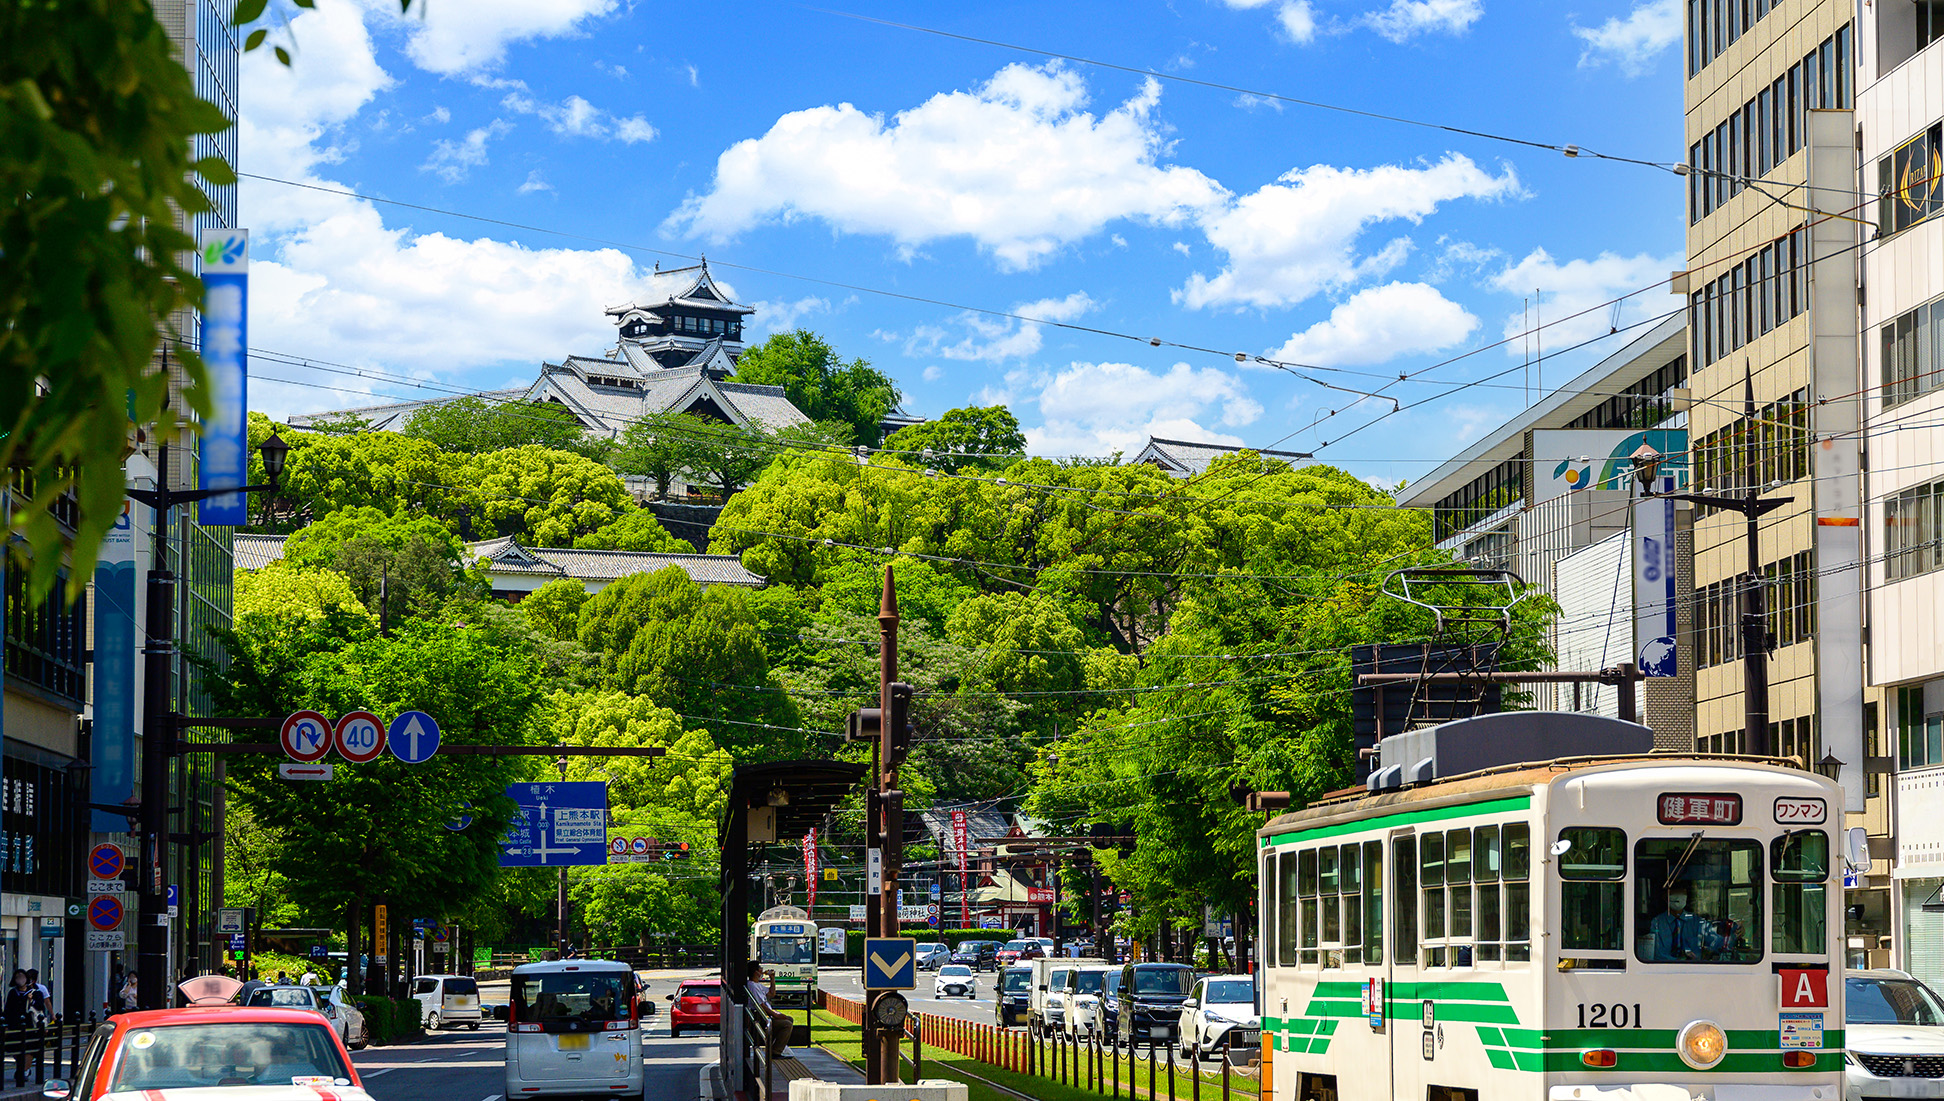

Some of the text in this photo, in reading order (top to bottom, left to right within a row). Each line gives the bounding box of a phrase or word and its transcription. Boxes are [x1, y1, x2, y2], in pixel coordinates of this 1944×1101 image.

[347, 726, 374, 748] 40
[530, 784, 555, 795] 植木
[558, 810, 600, 820] 上熊本駅
[1663, 796, 1736, 822] 健軍町
[1777, 804, 1823, 818] ワンマン
[556, 828, 603, 836] 県立総合体育館
[90, 883, 123, 891] ここまで
[1794, 972, 1814, 1003] A
[1577, 1003, 1642, 1028] 1201
